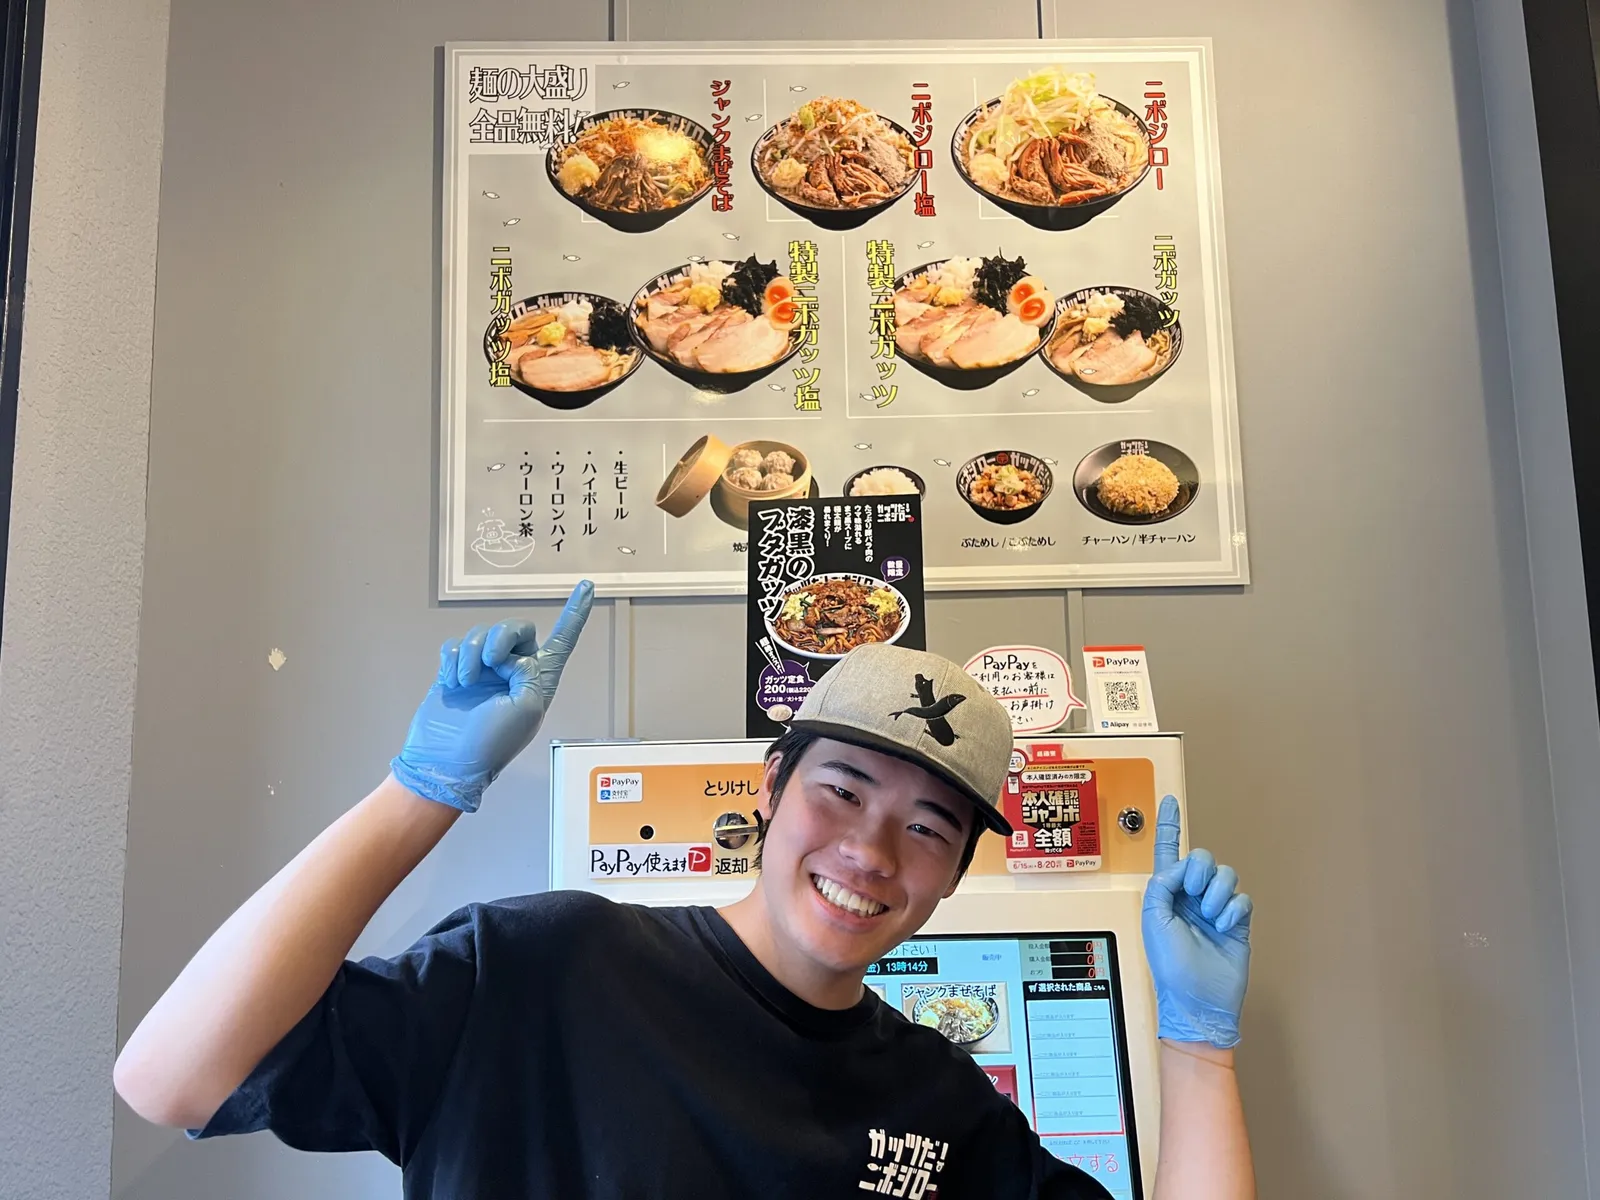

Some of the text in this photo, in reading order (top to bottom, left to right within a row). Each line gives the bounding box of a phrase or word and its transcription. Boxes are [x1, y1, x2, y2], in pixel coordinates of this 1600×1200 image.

[469, 65, 588, 102] 麺の大盛り
[709, 79, 733, 212] ジャンクまぜそば
[1144, 80, 1169, 190] ニボジロー
[911, 82, 936, 217] ニボジロー塩
[1153, 235, 1181, 328] ニボガッツ
[489, 246, 513, 387] ニボガッツ塩
[788, 240, 822, 411] 特製ニボガッツ塩
[866, 240, 898, 409] 特製ニボガッツ
[786, 506, 815, 580] 漆黒の
[1106, 657, 1140, 666] PayPay
[1110, 720, 1130, 728] Alipay
[612, 778, 639, 786] PayPay
[704, 780, 759, 796] とりけし
[1022, 789, 1079, 806] 本人確認
[1022, 805, 1080, 823] ジャンボ
[1033, 828, 1073, 848] 全額
[715, 858, 748, 875] 返却
[886, 961, 928, 973] 13時14分
[903, 984, 997, 998] ジャンクまぜそば
[868, 1129, 949, 1172] ガッツだ！
